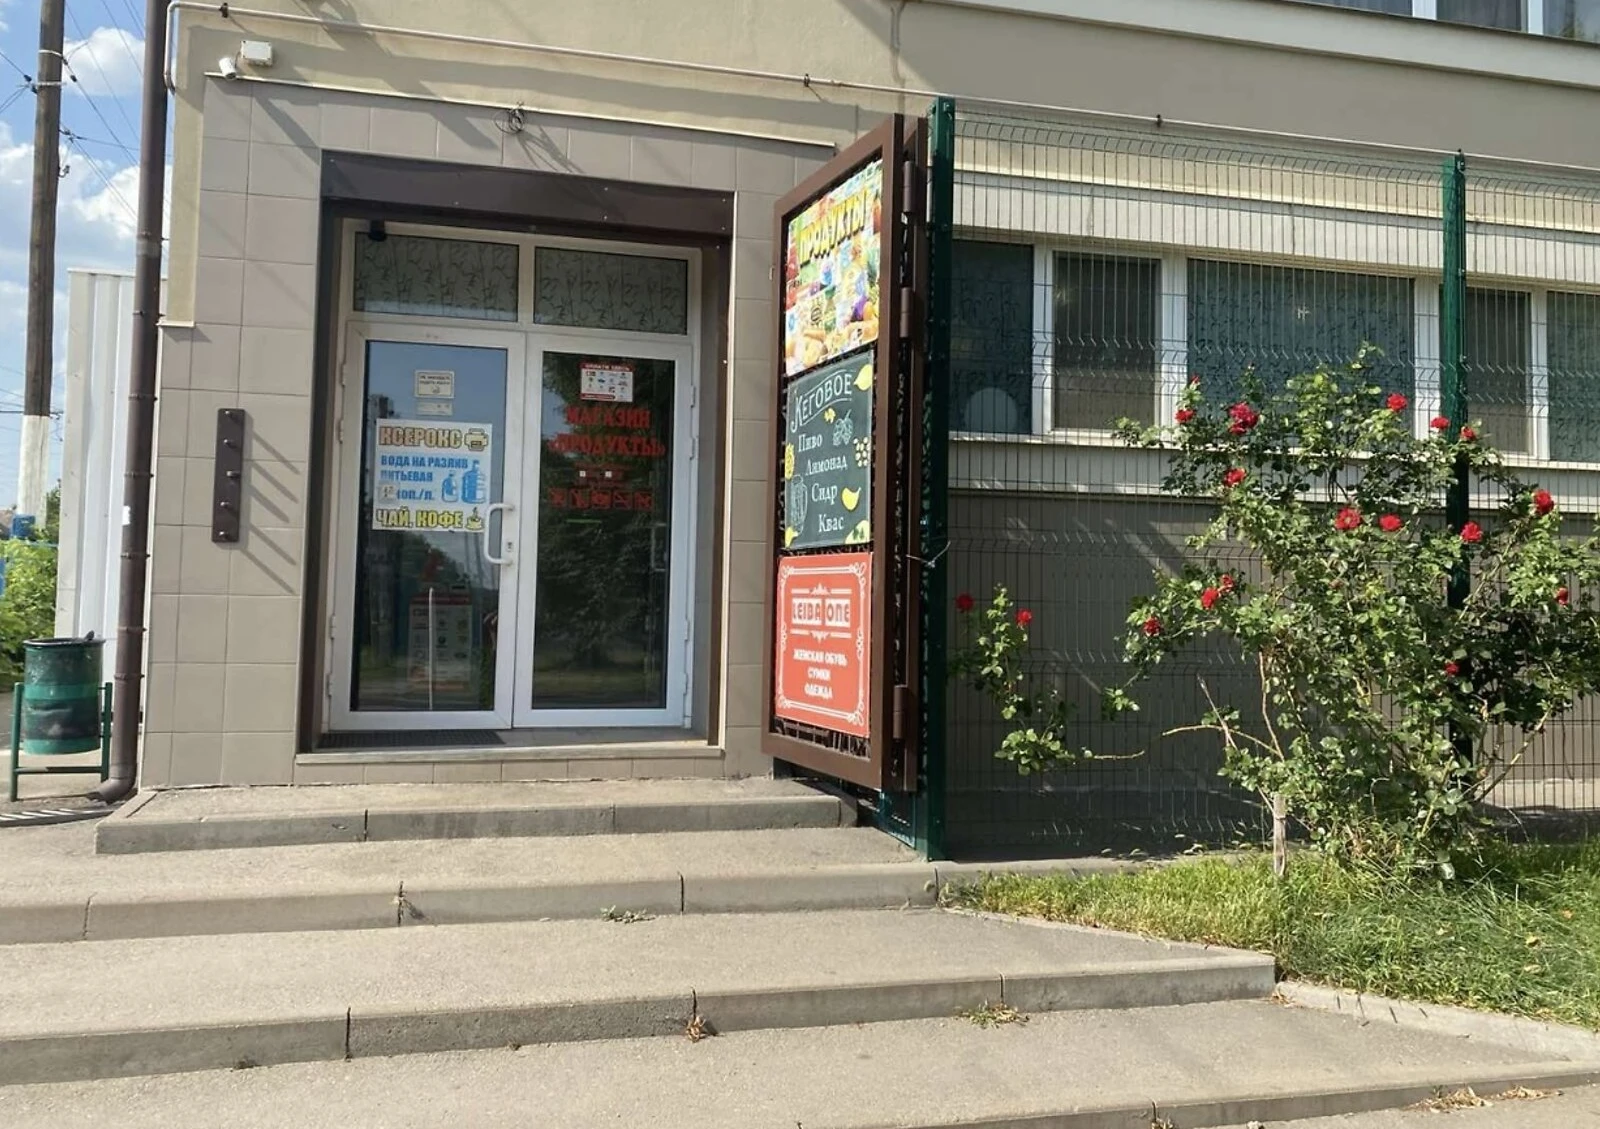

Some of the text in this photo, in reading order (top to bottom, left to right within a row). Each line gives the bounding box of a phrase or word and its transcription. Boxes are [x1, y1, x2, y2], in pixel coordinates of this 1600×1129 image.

[799, 187, 868, 267] ПРОДУКТЫ
[565, 406, 651, 428] МАГАЗИН
[378, 427, 463, 449] КСЕРОКС
[798, 433, 823, 452] Пиво
[381, 455, 468, 468] ВОДА НА РАЗЛИВ
[811, 482, 838, 505] Сидр
[376, 507, 463, 529] ЧАЙ, КОФЕ
[818, 514, 844, 532] Квас
[827, 603, 850, 623] ONE
